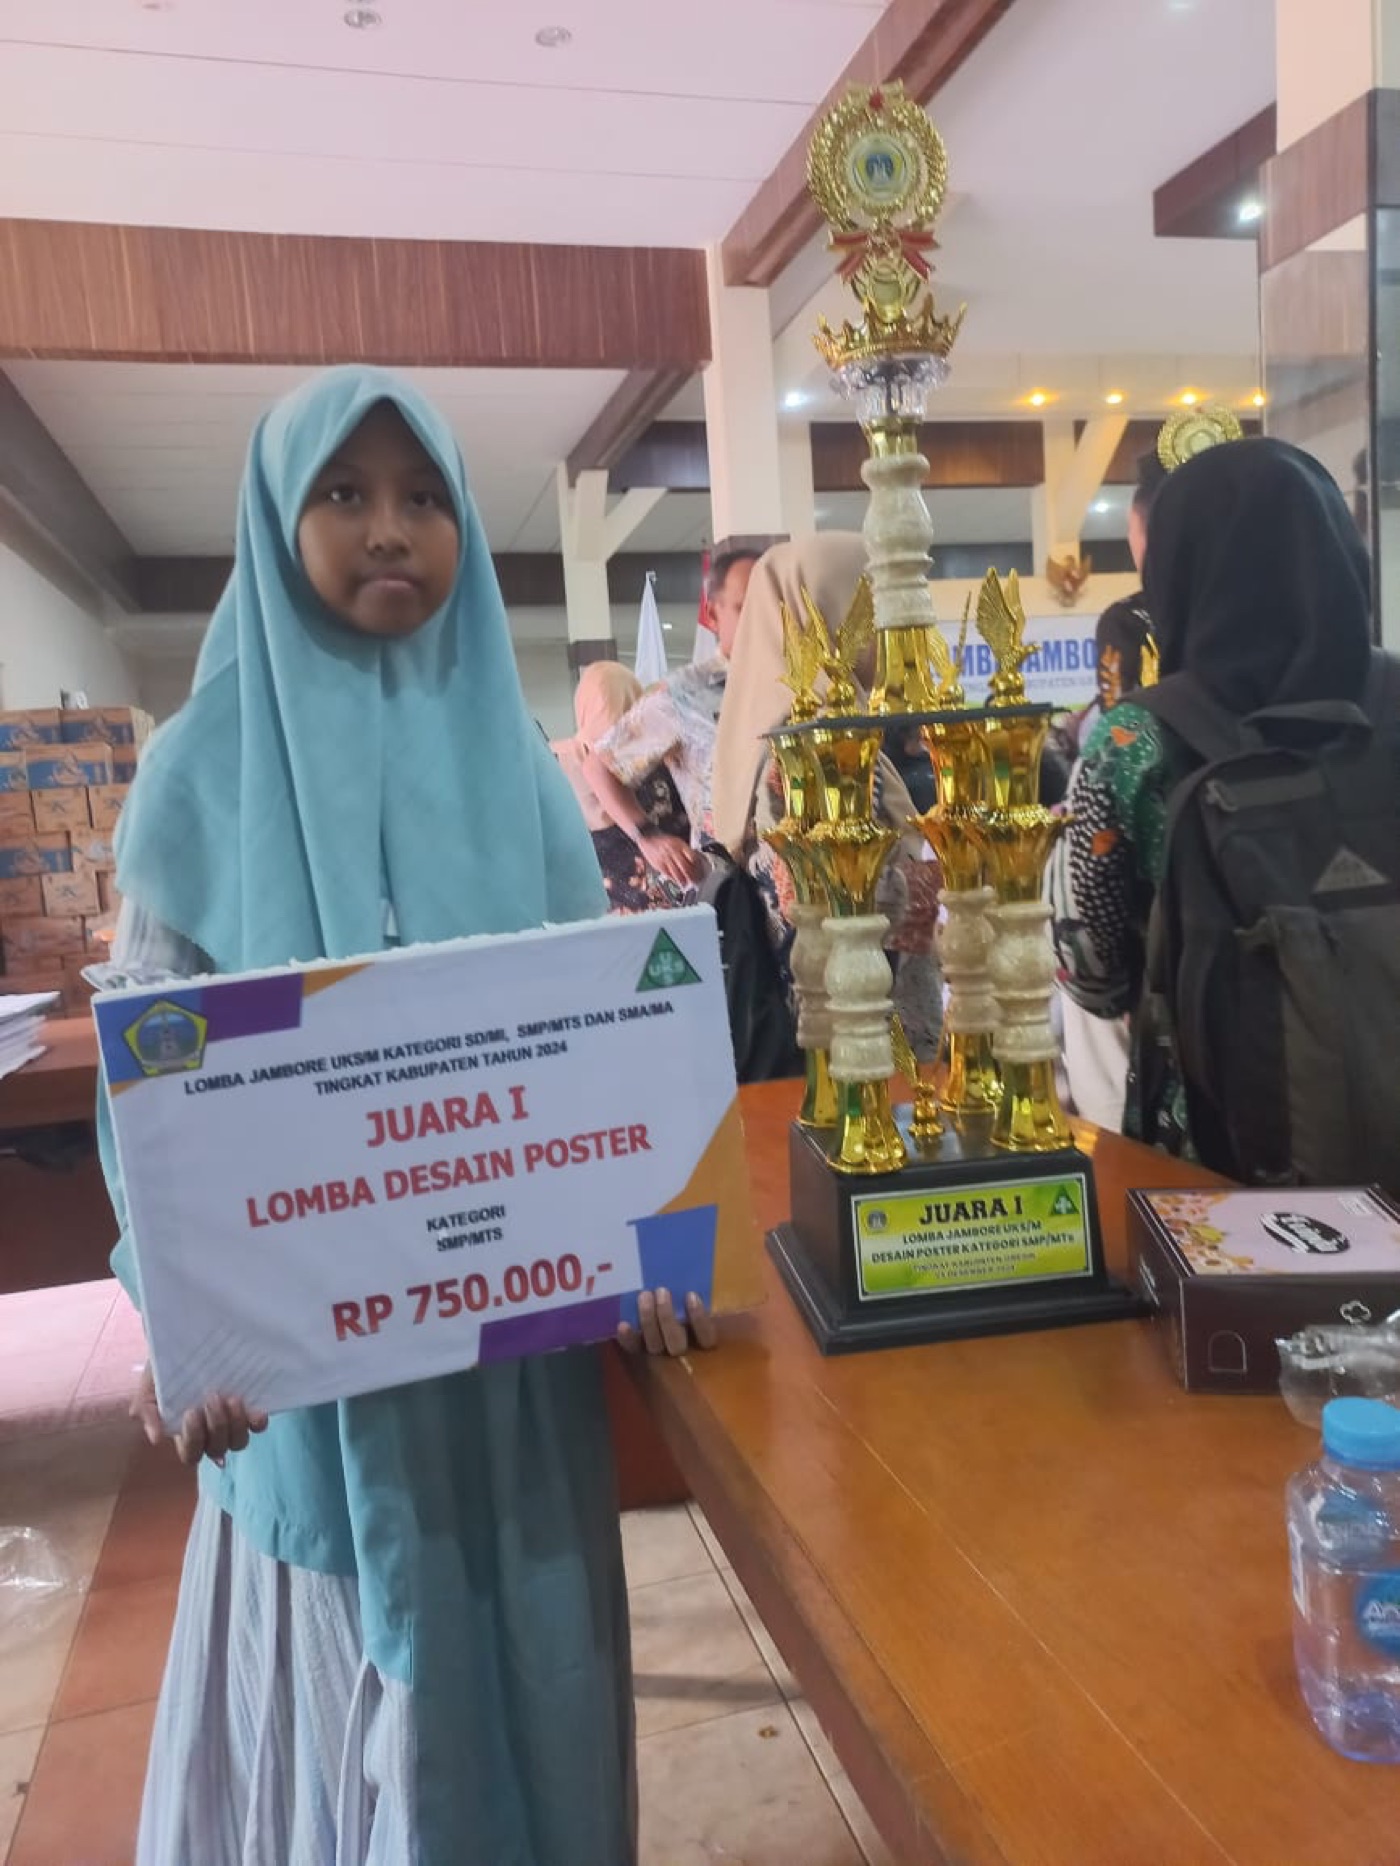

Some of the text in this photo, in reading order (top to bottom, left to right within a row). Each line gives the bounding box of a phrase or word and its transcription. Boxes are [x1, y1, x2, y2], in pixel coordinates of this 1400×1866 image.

[184, 1072, 246, 1096] LOMBA
[249, 1057, 329, 1084] JAMBORE
[383, 1034, 462, 1062] KATEGORI
[517, 1014, 582, 1039] SMP/MTS
[584, 1008, 615, 1028] DAN
[618, 1000, 675, 1022] SMA/MA
[314, 1040, 568, 1096] TINGKAT KABUPATEN TAHUN 2024
[366, 1084, 529, 1148] JUARA I
[246, 1123, 652, 1228] LOMBA DESAIN POSTER
[426, 1204, 506, 1252] KATEGORI SMP/MTS
[903, 1230, 944, 1244] LOMBA
[946, 1224, 1000, 1240] JAMBORE
[919, 1195, 1023, 1225] JUARA I
[871, 1249, 915, 1263] DESAIN
[917, 1243, 960, 1258] POSTER
[962, 1239, 1020, 1254] KATEGORI
[332, 1253, 613, 1341] RP 750.000,-
